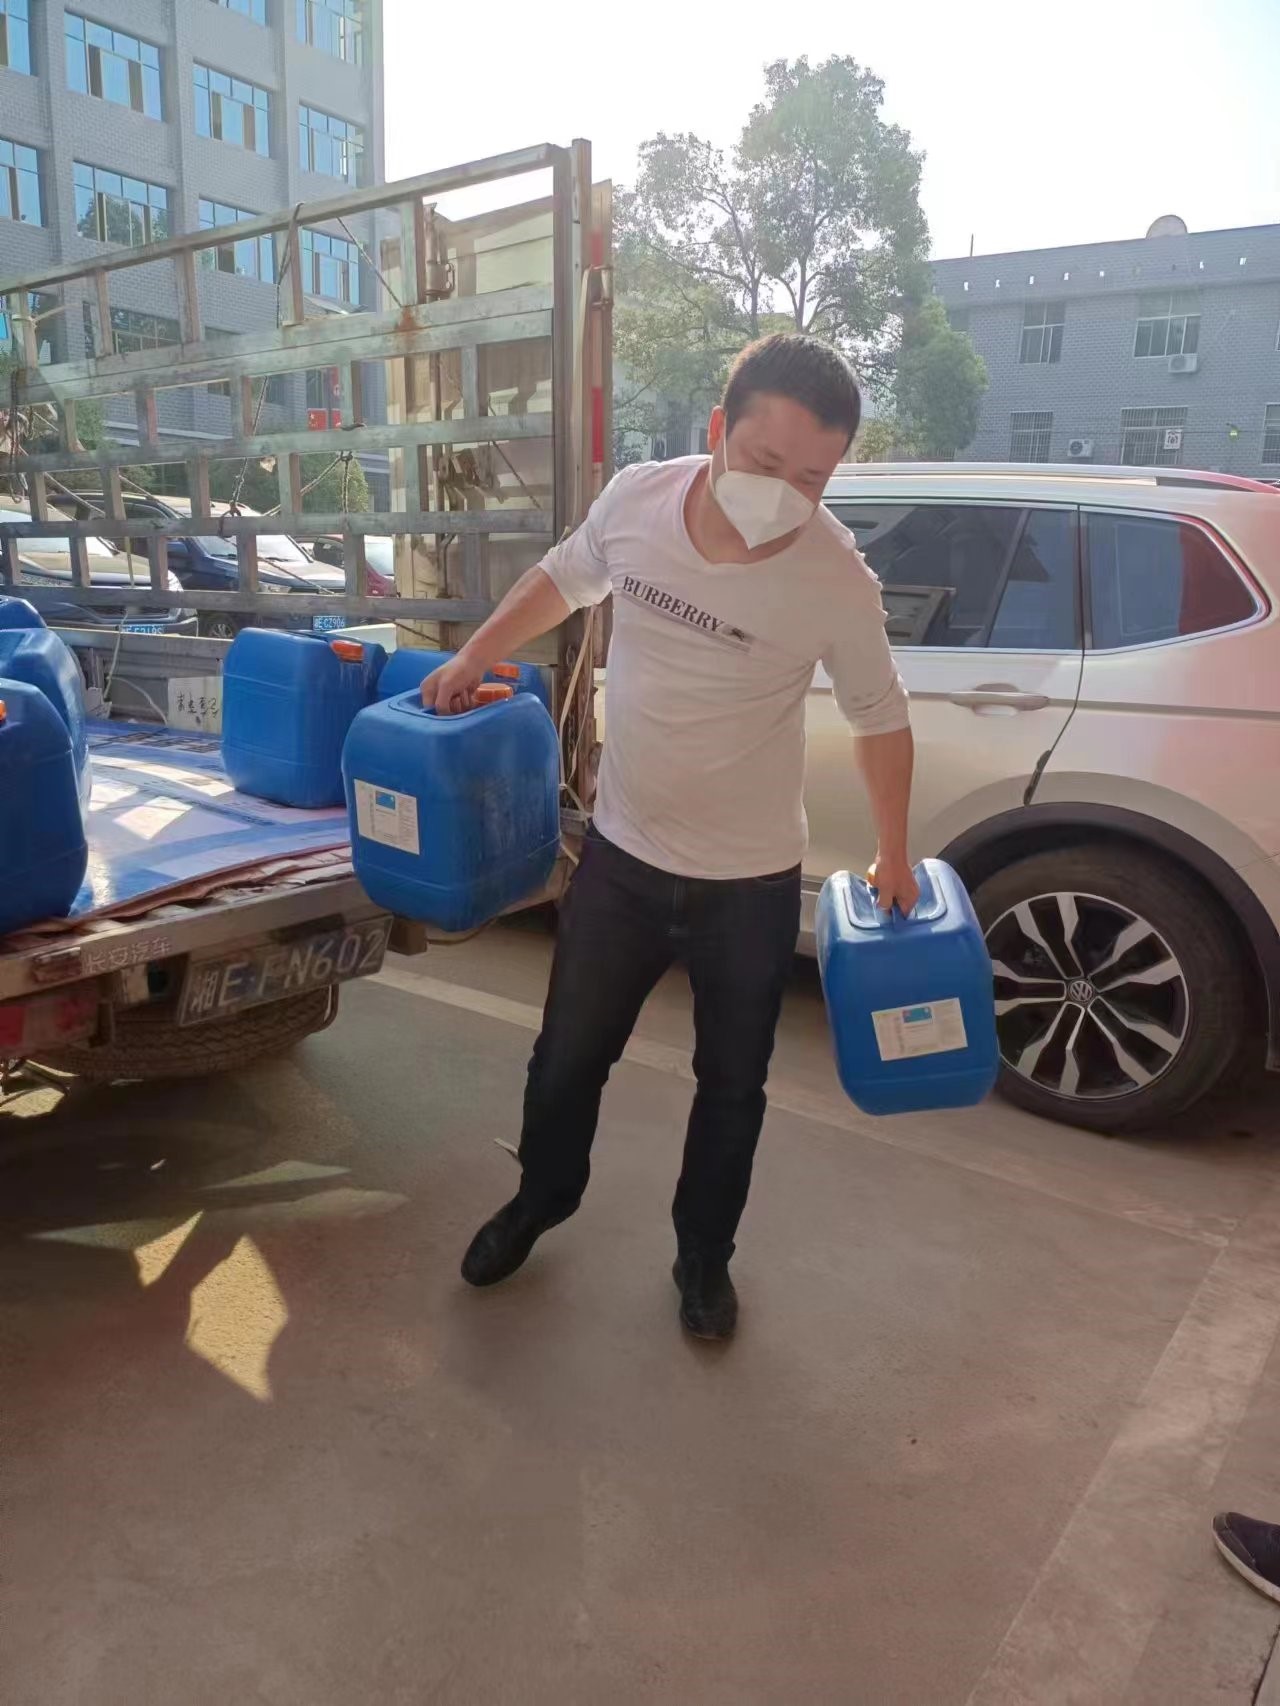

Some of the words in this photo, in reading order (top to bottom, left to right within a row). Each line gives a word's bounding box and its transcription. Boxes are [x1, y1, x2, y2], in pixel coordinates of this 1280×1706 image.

[623, 576, 725, 632] BURBERRY
[86, 936, 171, 974] 长安汽车
